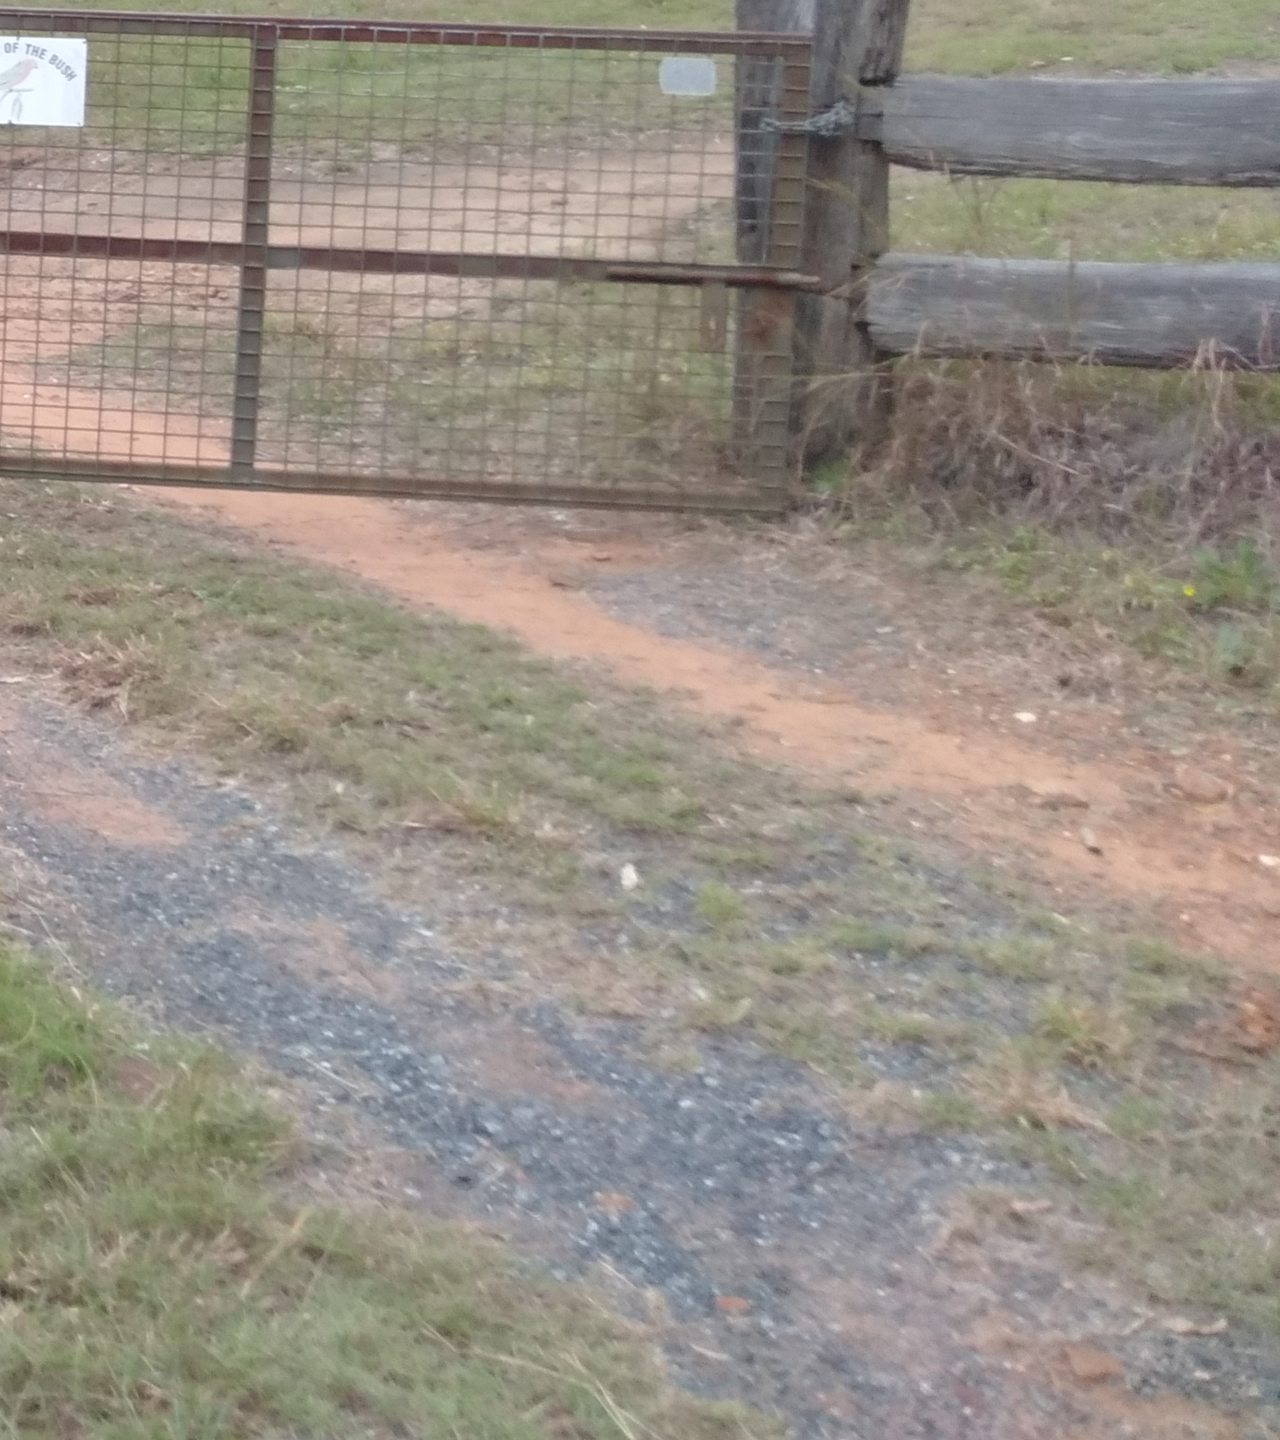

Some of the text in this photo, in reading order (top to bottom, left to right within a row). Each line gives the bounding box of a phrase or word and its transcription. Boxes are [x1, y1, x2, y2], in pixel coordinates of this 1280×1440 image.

[4, 42, 19, 54] OF
[25, 43, 48, 60] THE
[48, 54, 78, 81] BUSH
